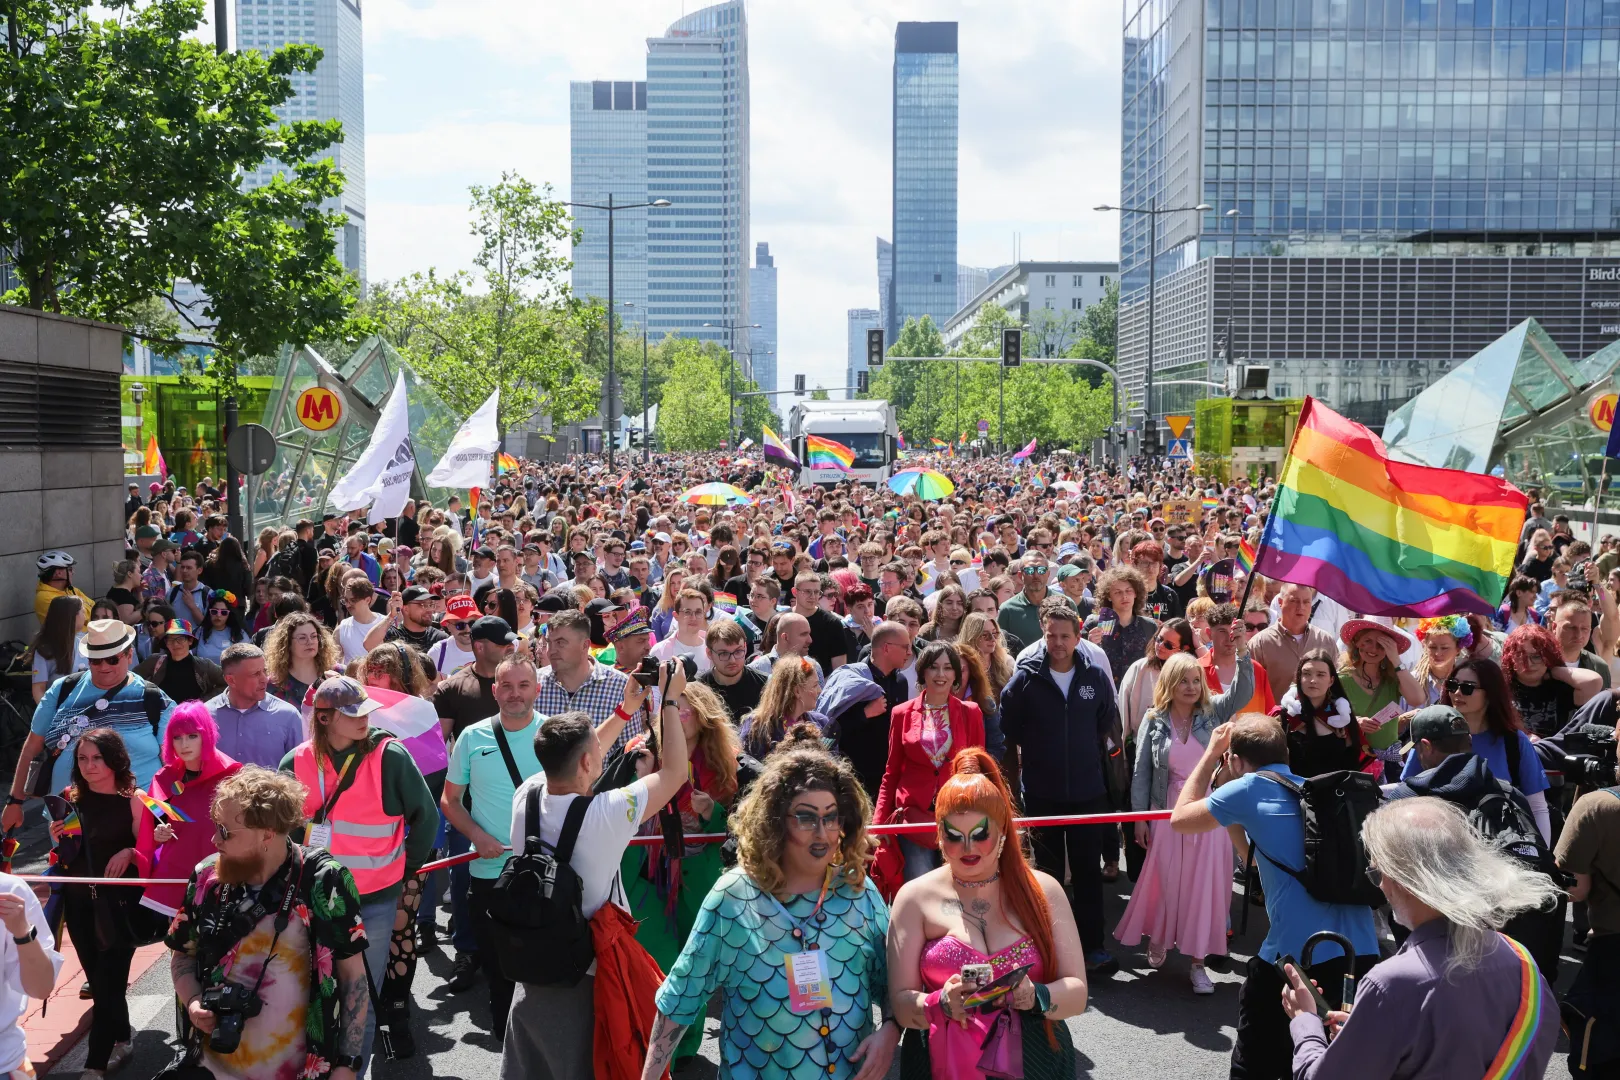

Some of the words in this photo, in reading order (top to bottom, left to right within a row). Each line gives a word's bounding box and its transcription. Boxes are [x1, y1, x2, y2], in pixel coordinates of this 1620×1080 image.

[302, 394, 334, 423] M
[448, 600, 474, 611] VELUX
[282, 884, 296, 911] Canon
